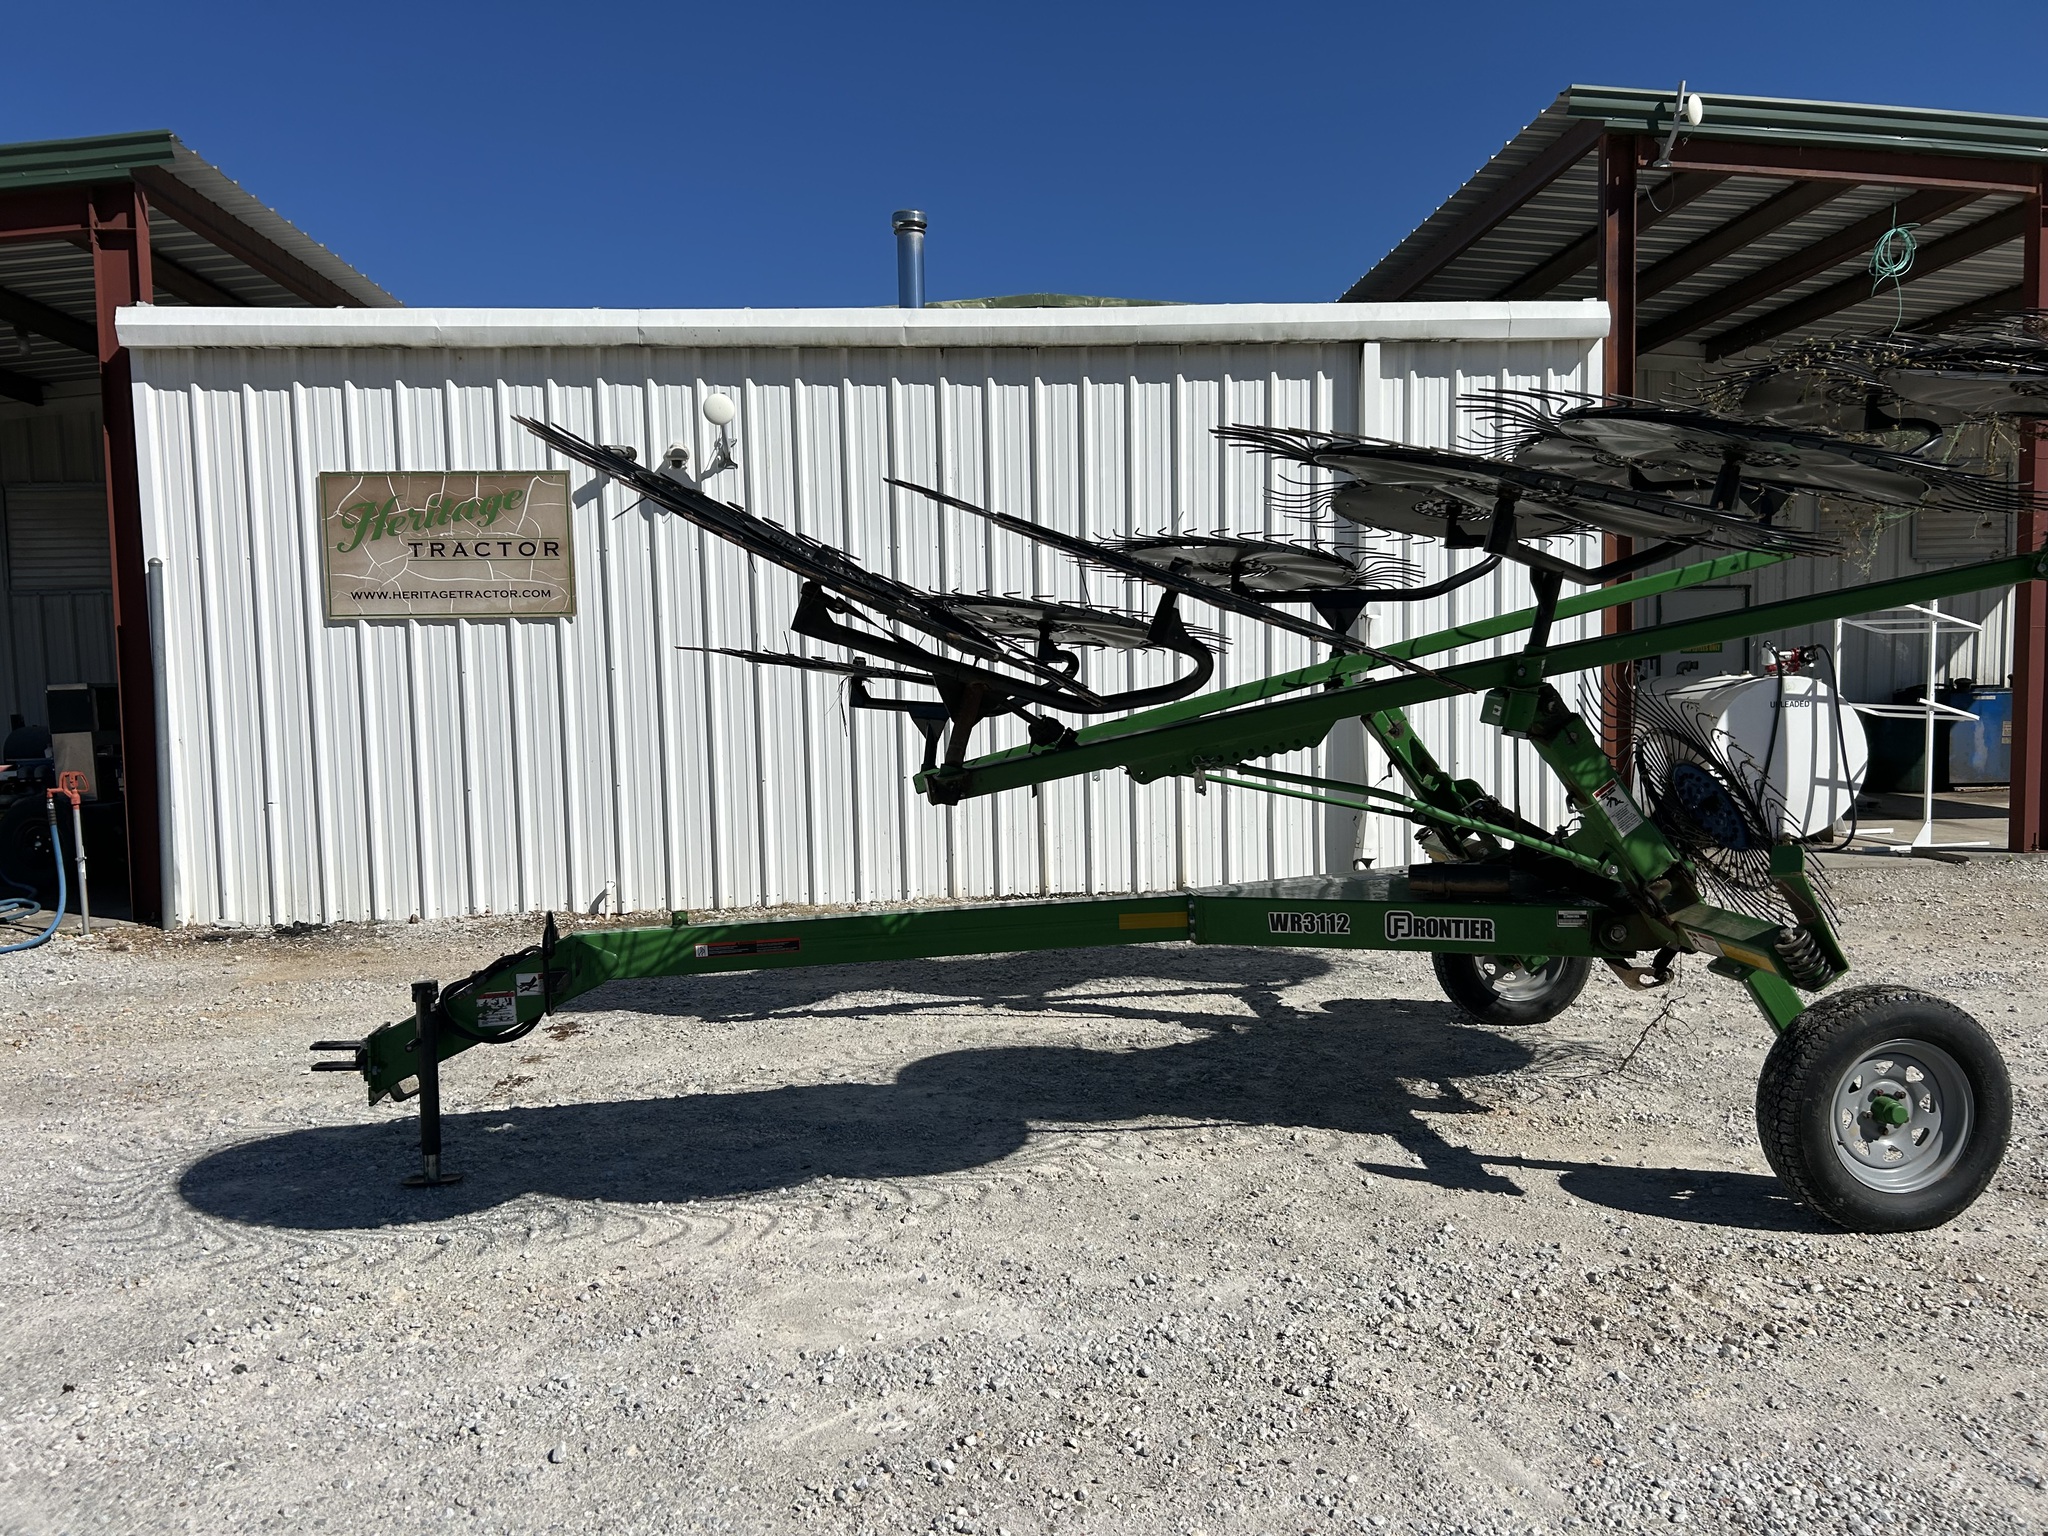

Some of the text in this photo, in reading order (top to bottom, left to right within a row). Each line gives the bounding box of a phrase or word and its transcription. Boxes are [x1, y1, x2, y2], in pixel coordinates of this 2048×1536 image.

[337, 489, 525, 553] Heritage
[408, 541, 559, 558] TRACTOR
[351, 589, 551, 600] WWW.HERITAGETRACTOR.COM
[1770, 700, 1810, 708] ULEADED
[1269, 912, 1350, 934] WR3112
[1386, 910, 1495, 942] FRONTIER
